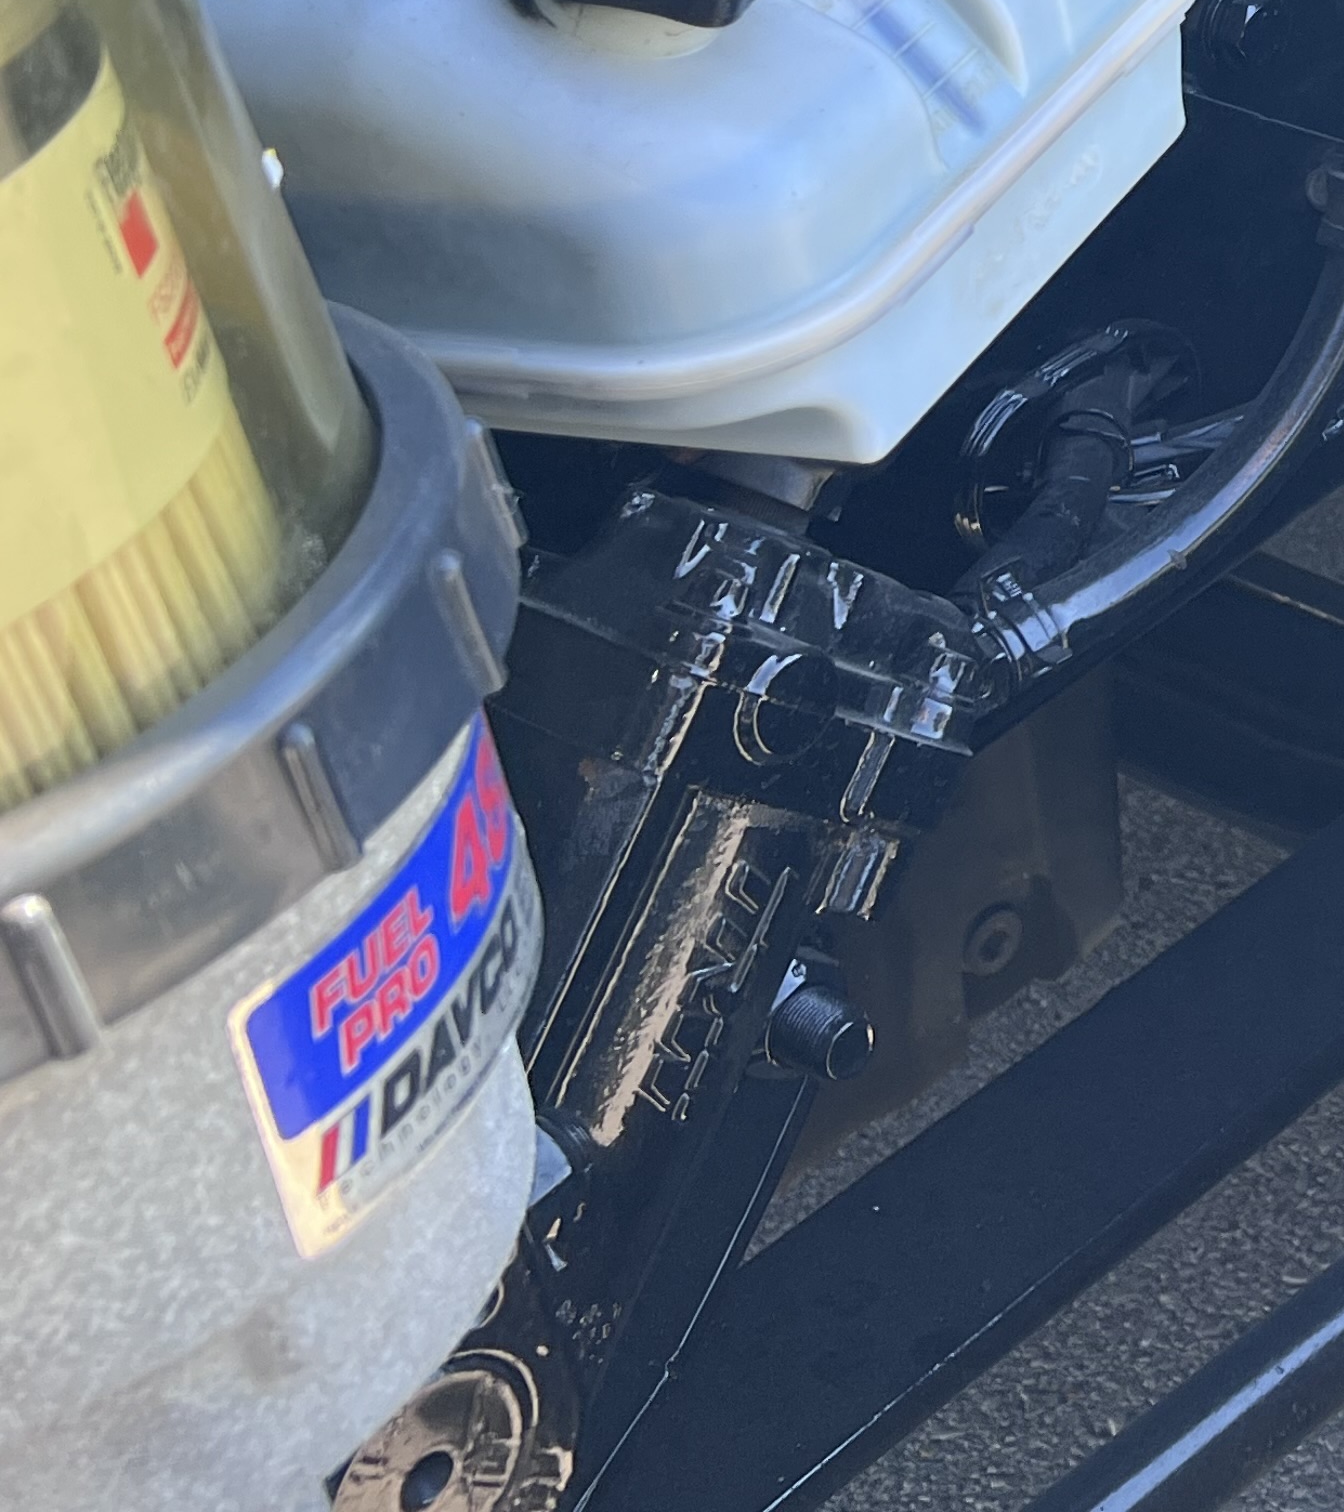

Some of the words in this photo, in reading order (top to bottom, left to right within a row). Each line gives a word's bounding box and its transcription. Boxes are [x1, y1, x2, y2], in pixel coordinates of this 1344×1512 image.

[309, 884, 434, 1041] FUEL
[337, 932, 439, 1075] PRO
[380, 893, 520, 1139] DAVCO
